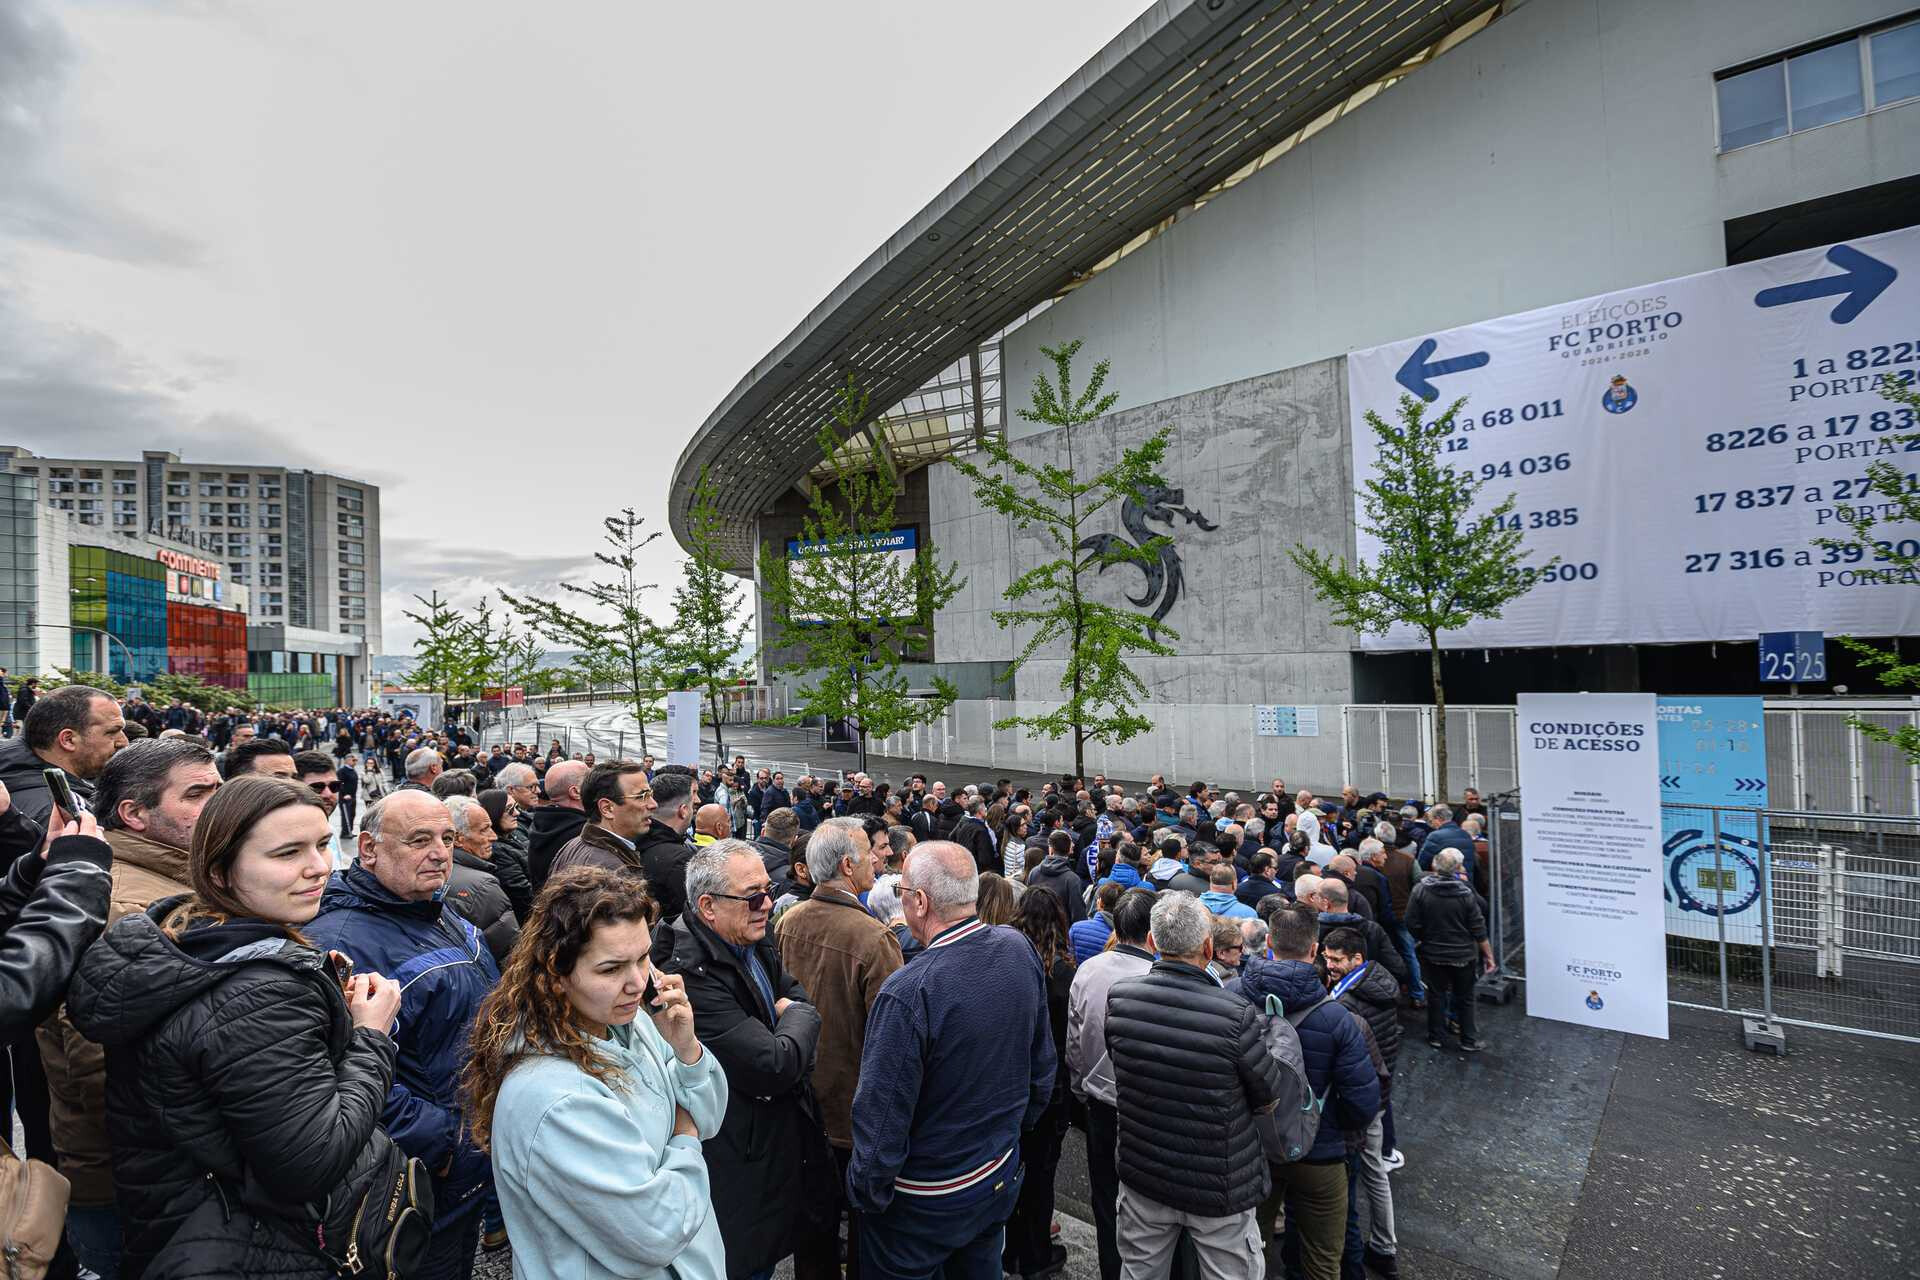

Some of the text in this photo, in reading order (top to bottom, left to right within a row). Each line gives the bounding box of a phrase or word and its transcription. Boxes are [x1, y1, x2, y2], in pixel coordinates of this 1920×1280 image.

[1548, 311, 1683, 352] FC PORTO
[1793, 358, 1809, 379] 1
[1817, 358, 1837, 375] a
[1789, 373, 1890, 402] PORTA
[1462, 417, 1476, 432] a
[1481, 407, 1515, 428] 68
[1521, 399, 1564, 421] 011
[1447, 437, 1469, 452] 12
[1706, 423, 1788, 452] 8226
[1797, 424, 1815, 440] a
[1824, 414, 1859, 437] 17
[1795, 439, 1896, 464] PORTA
[1481, 460, 1513, 482] 94
[1519, 453, 1571, 476] 036
[1695, 492, 1726, 514] 17
[1735, 485, 1795, 509] 837
[1804, 486, 1822, 502] a
[1832, 477, 1873, 500] 27
[1529, 508, 1579, 529] 385
[1544, 562, 1598, 583] 500
[1685, 552, 1721, 574] 27
[1729, 548, 1785, 571] 316
[1794, 549, 1811, 566] a
[1766, 652, 1796, 680] 25
[1800, 652, 1825, 680] 25
[1656, 705, 1703, 714] ORTAS
[1530, 721, 1645, 738] CONDIÇÕES
[1535, 737, 1640, 752] DE ACESSO
[1566, 964, 1622, 979] FC PORTO
